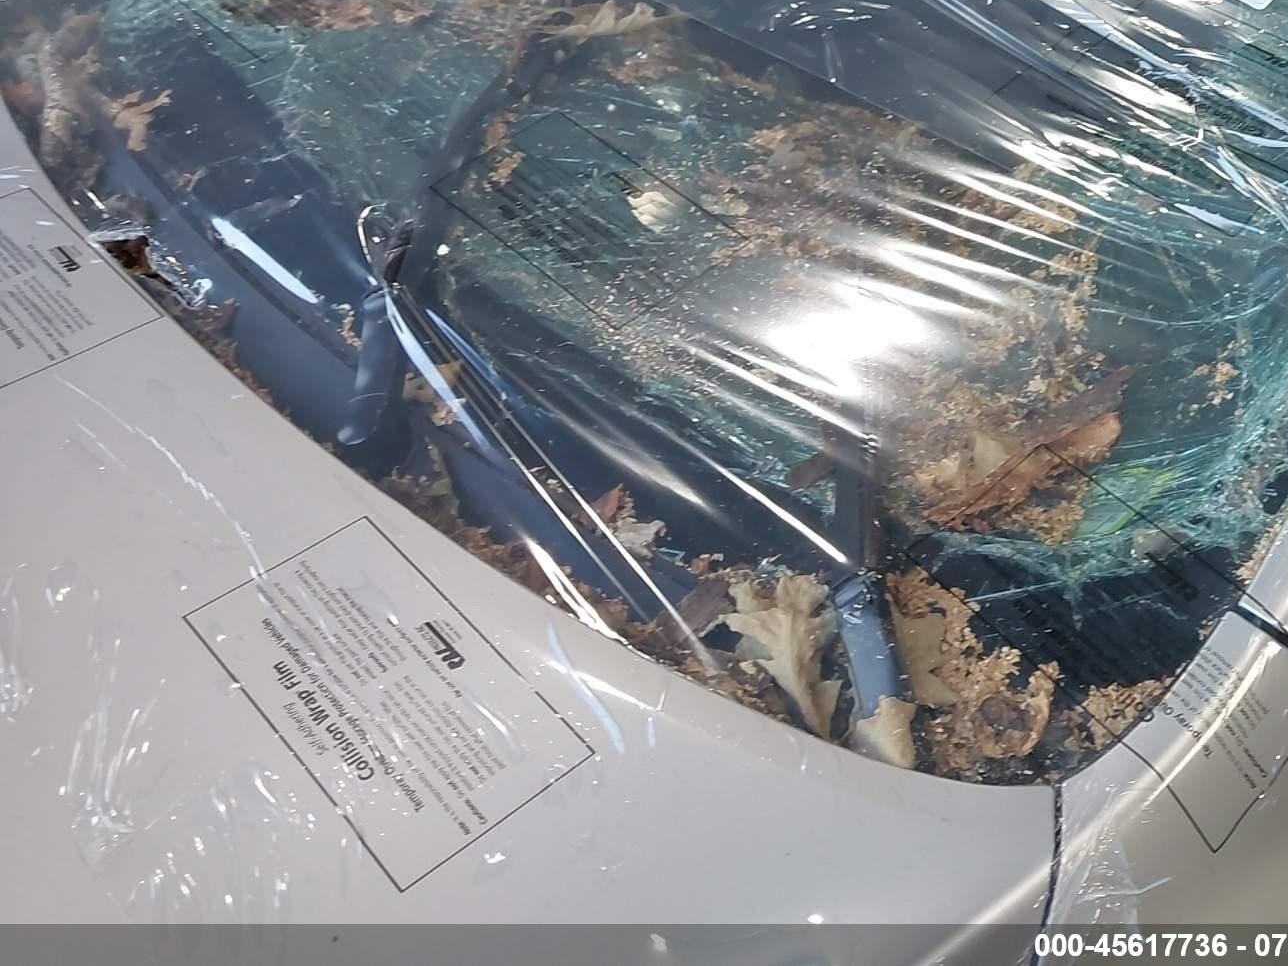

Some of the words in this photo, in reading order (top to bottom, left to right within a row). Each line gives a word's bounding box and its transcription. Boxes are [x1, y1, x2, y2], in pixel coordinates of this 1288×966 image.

[258, 617, 286, 645] Vehicles
[279, 640, 313, 674] Damaged
[268, 659, 301, 691] Film
[304, 670, 320, 684] for
[313, 681, 349, 718] Protection
[319, 721, 377, 783] Collision
